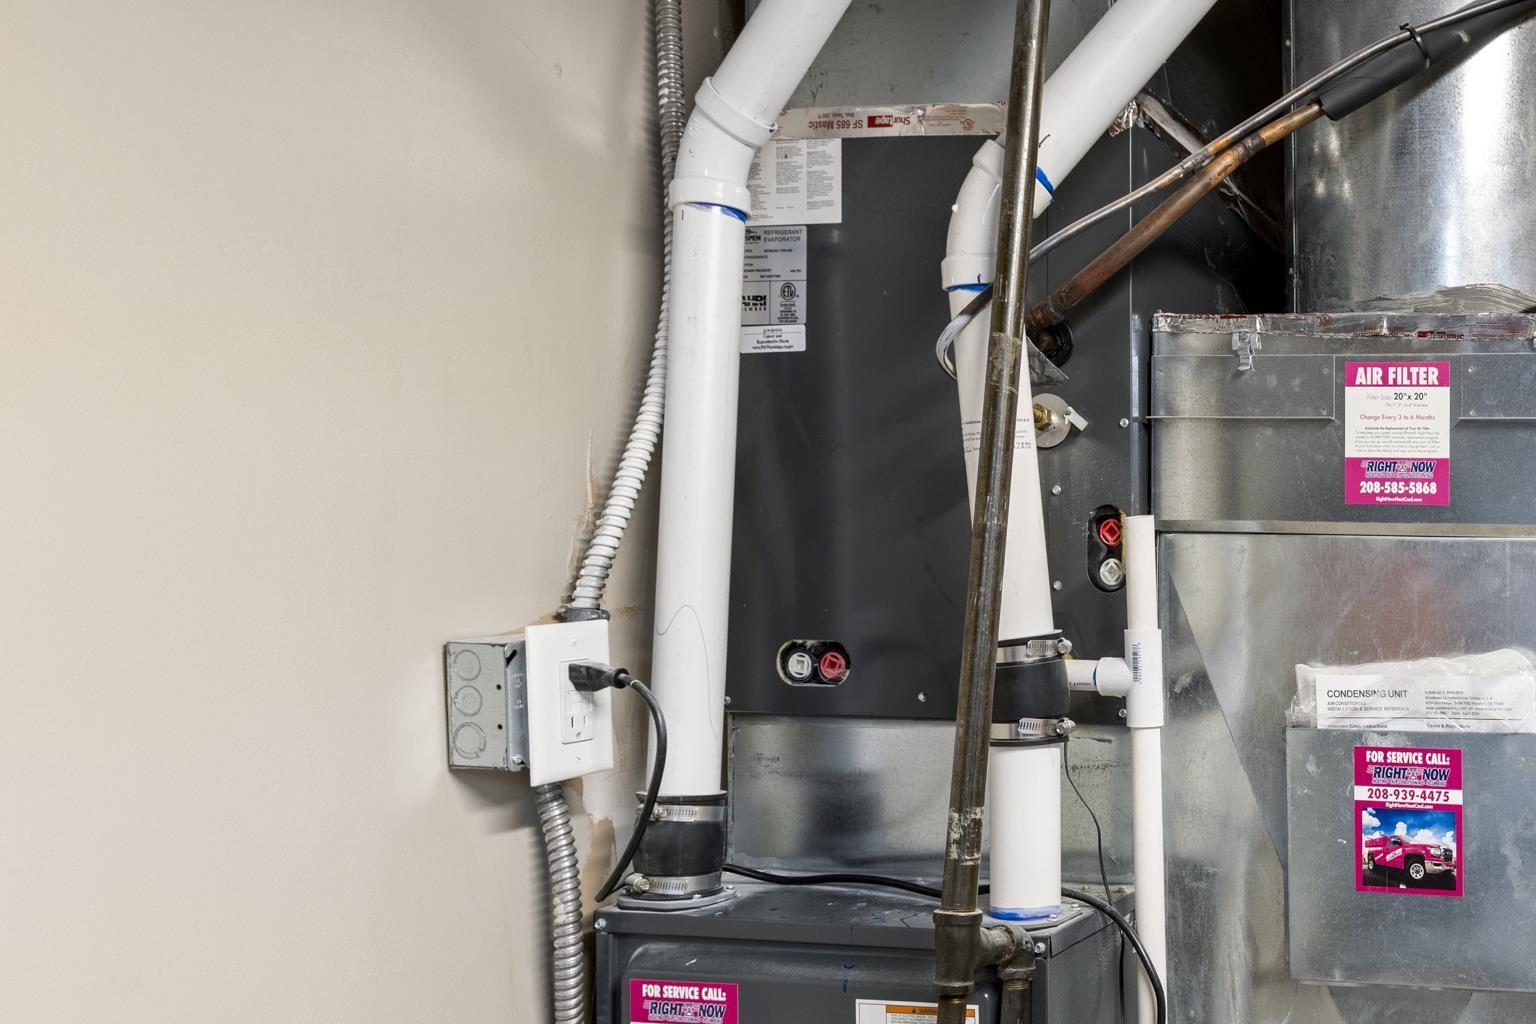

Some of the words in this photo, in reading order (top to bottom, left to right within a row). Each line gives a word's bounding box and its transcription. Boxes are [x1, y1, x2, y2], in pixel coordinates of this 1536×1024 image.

[808, 120, 832, 129] Mastic
[833, 120, 851, 129] 685
[852, 119, 863, 129] SF
[1355, 367, 1383, 385] AIR
[1388, 367, 1439, 385] FILTER
[1366, 461, 1397, 472] RIGHT
[1411, 461, 1435, 472] NOW
[1359, 481, 1437, 494] 208-585-5868
[1327, 690, 1387, 698] CONDENSING
[1388, 690, 1408, 698] UNIT
[1365, 751, 1384, 763] FOR
[1386, 751, 1423, 764] SERVICE
[1425, 753, 1450, 765] CALL:
[1373, 766, 1408, 779] RIGHT
[1422, 768, 1450, 781] NOW
[1367, 788, 1450, 802] 208-939-4475
[642, 984, 661, 998] FOR
[662, 985, 699, 1000] SERVICE
[701, 987, 727, 1001] CALL:
[649, 1001, 684, 1015] RIGHT
[698, 1004, 726, 1018] NOW
